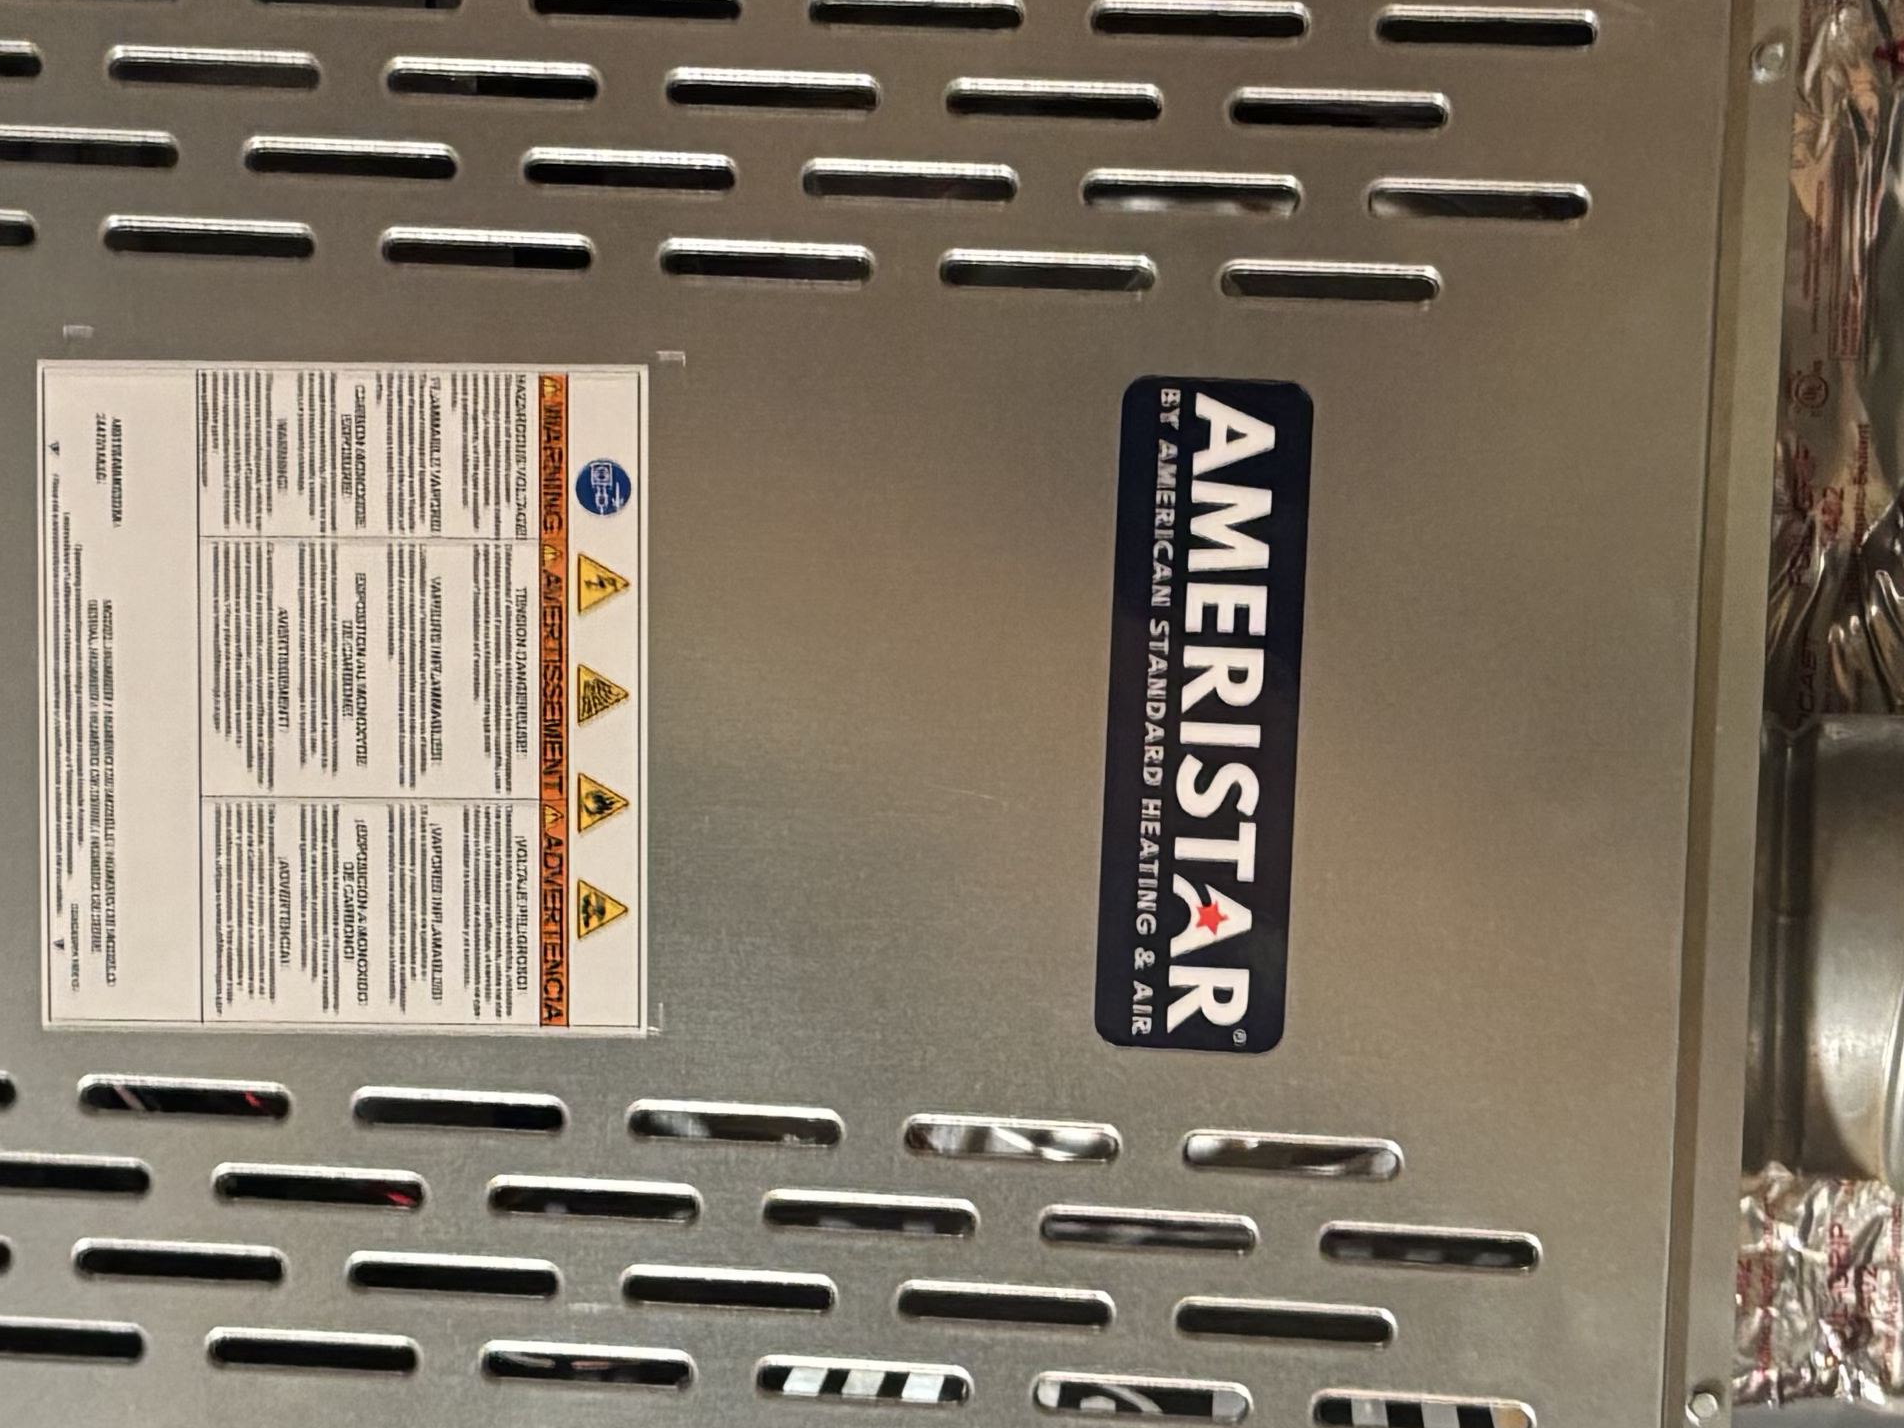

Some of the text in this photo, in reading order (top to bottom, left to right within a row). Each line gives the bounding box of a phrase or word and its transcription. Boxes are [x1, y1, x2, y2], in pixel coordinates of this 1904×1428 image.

[541, 401, 563, 1023] WARNING AVERTISSEMENT ADVERTENCIA
[1130, 388, 1180, 1036] BY AMERICAN STANDARD HEATING & AIR
[1852, 421, 1870, 485] Sealant
